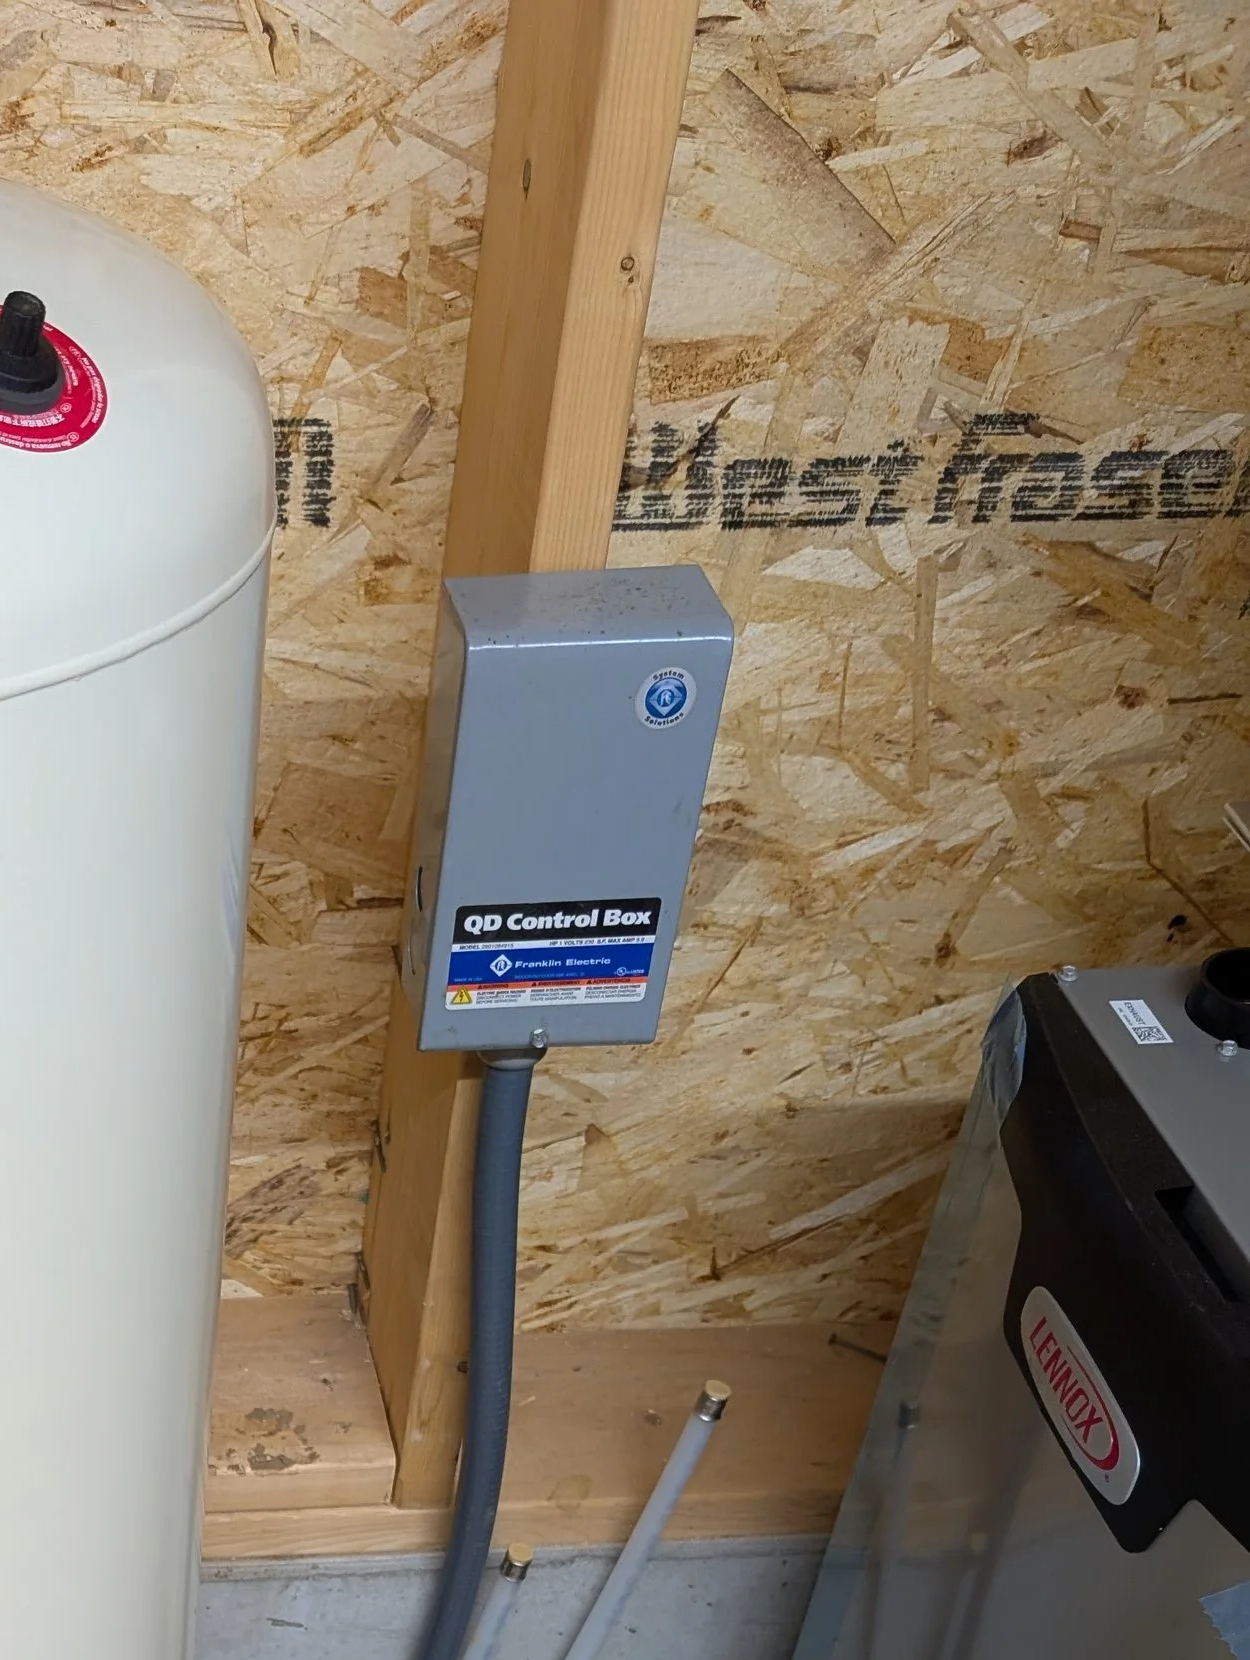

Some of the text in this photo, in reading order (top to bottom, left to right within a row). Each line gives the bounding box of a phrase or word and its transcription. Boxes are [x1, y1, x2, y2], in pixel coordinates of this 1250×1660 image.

[612, 421, 924, 531] West
[653, 670, 685, 681] System
[645, 712, 684, 726] Solutions
[463, 909, 652, 935] QD Control Box
[514, 957, 611, 969] Franklin Electric
[1029, 1316, 1104, 1444] LENNOX
